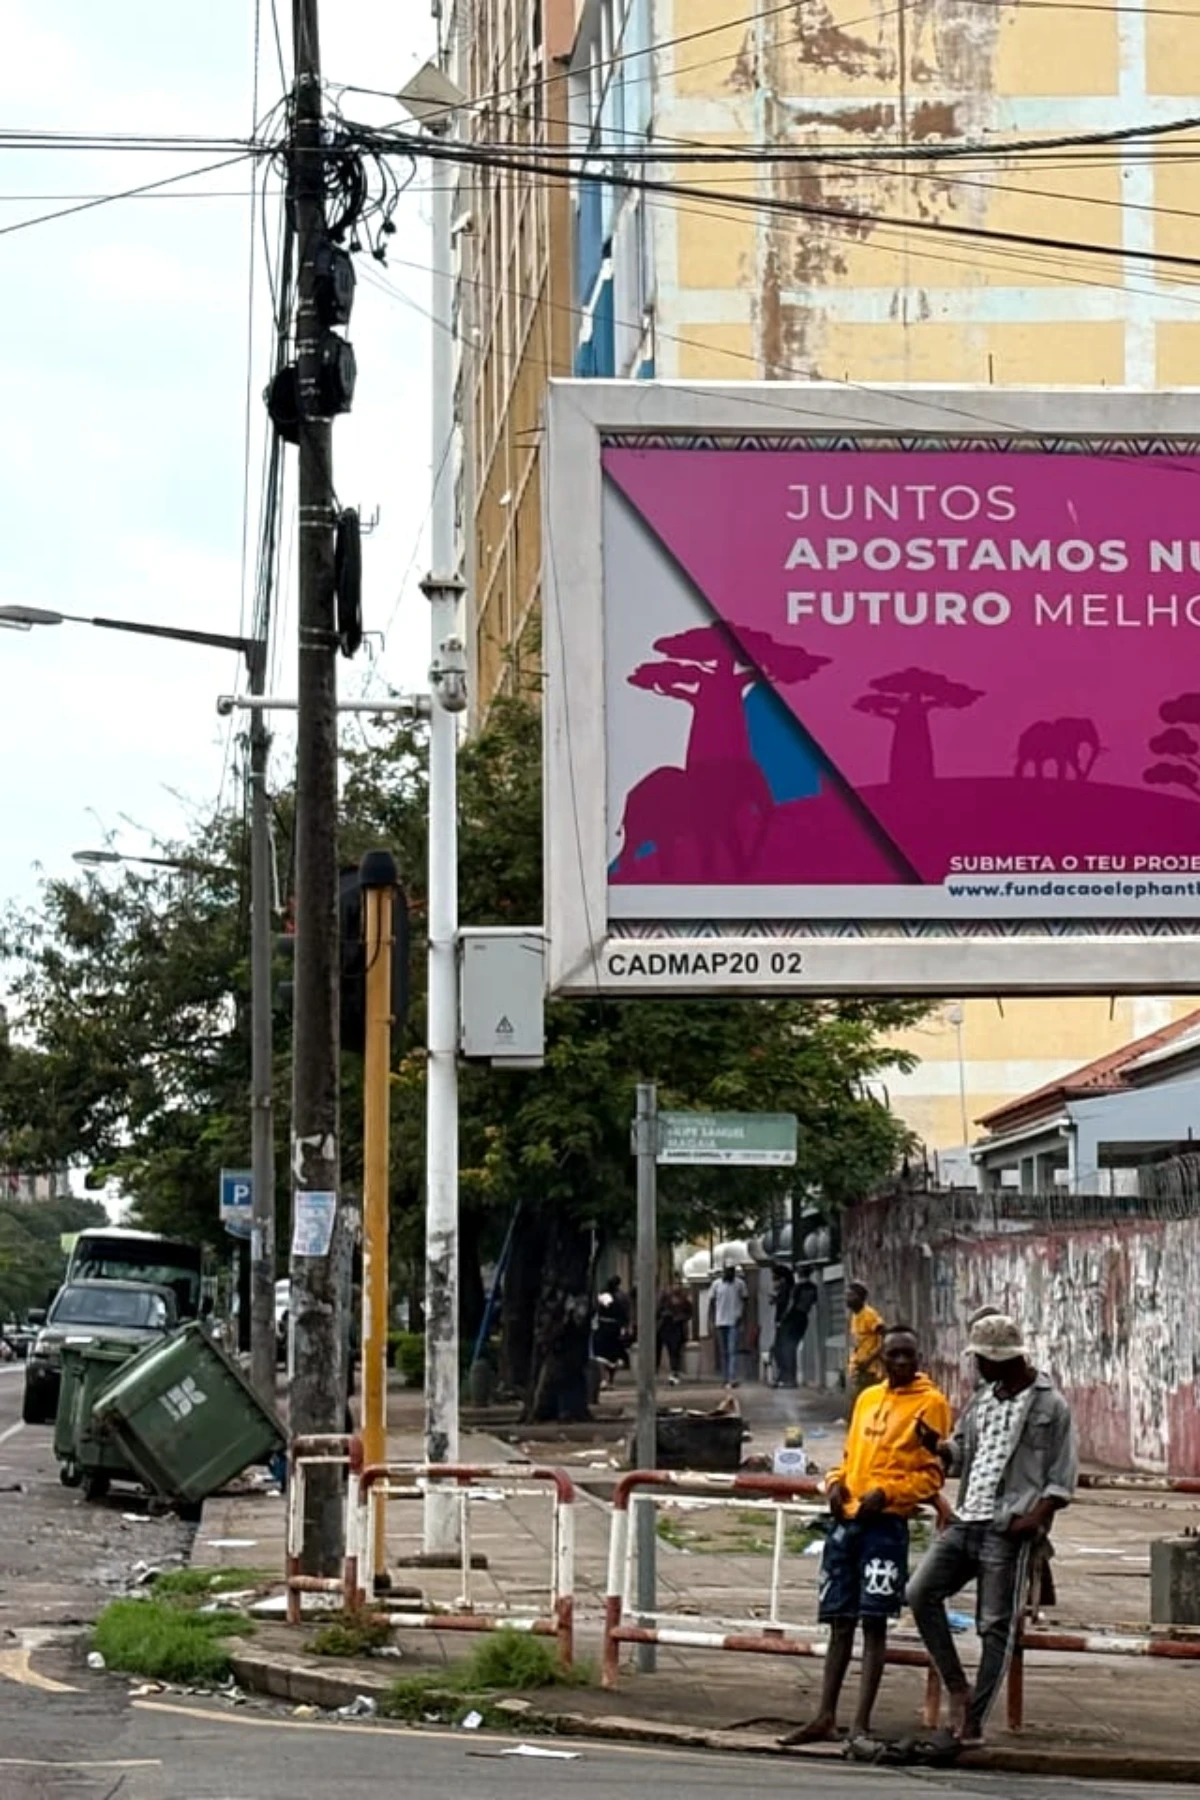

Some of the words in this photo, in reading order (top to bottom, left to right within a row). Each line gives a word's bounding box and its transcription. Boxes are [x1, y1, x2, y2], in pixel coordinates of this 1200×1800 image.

[785, 484, 1017, 521] JUNTOS
[784, 537, 1128, 572] APOSTAMOS
[787, 591, 1011, 626] FUTURO
[949, 855, 1055, 871] SUBMETA
[1061, 855, 1079, 871] O
[1085, 856, 1127, 871] TEU
[608, 952, 759, 975] CADMAP20
[770, 953, 802, 974] 02
[233, 1183, 250, 1205] P
